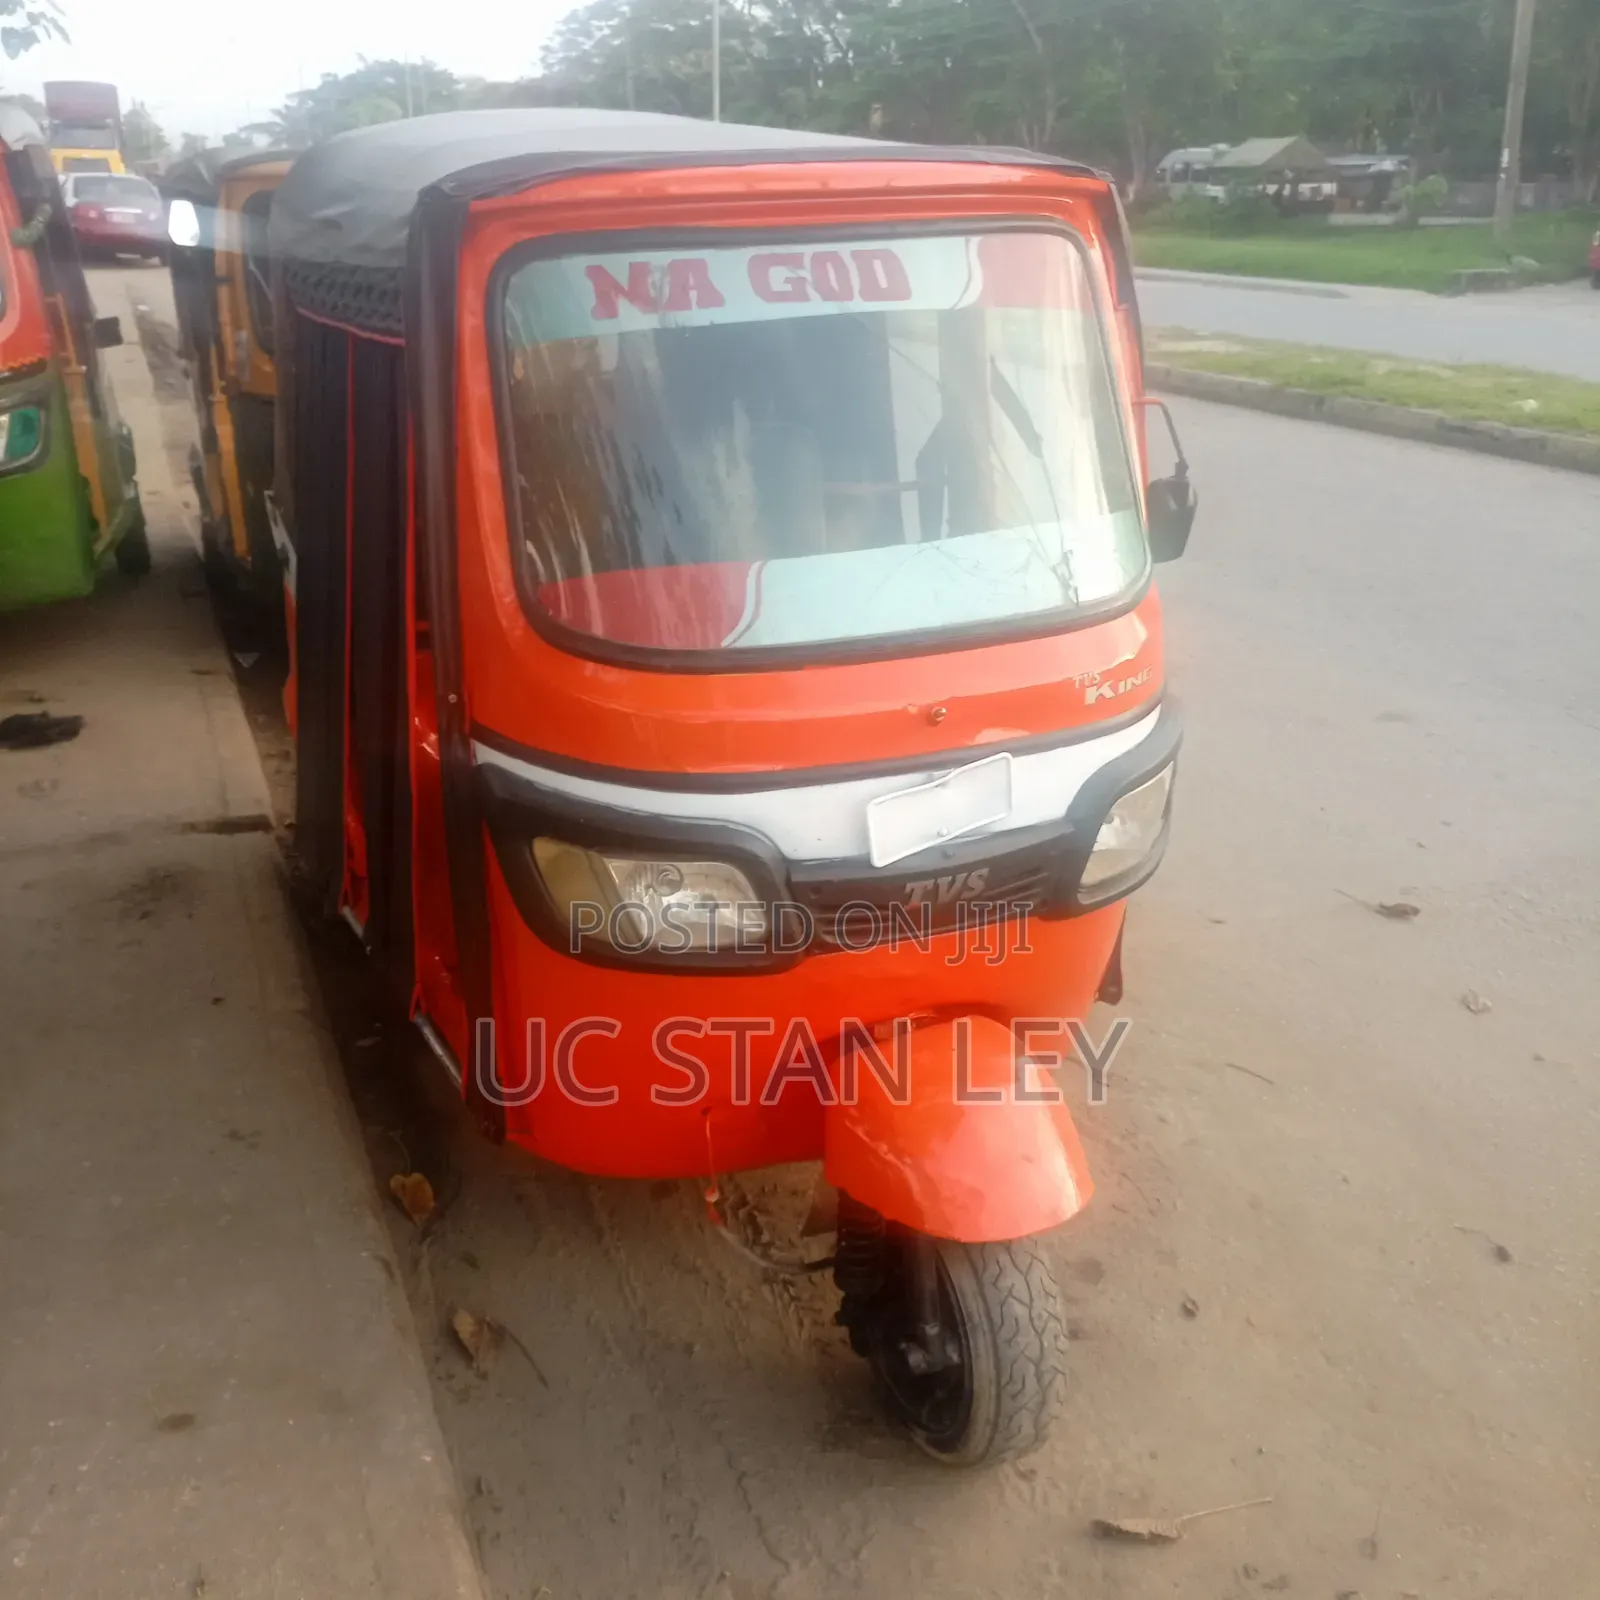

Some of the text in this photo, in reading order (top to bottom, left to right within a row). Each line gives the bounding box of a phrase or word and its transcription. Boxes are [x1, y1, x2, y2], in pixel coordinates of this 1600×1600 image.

[585, 249, 912, 320] NA GOD
[1073, 671, 1101, 689] TVS
[904, 868, 989, 908] TVS
